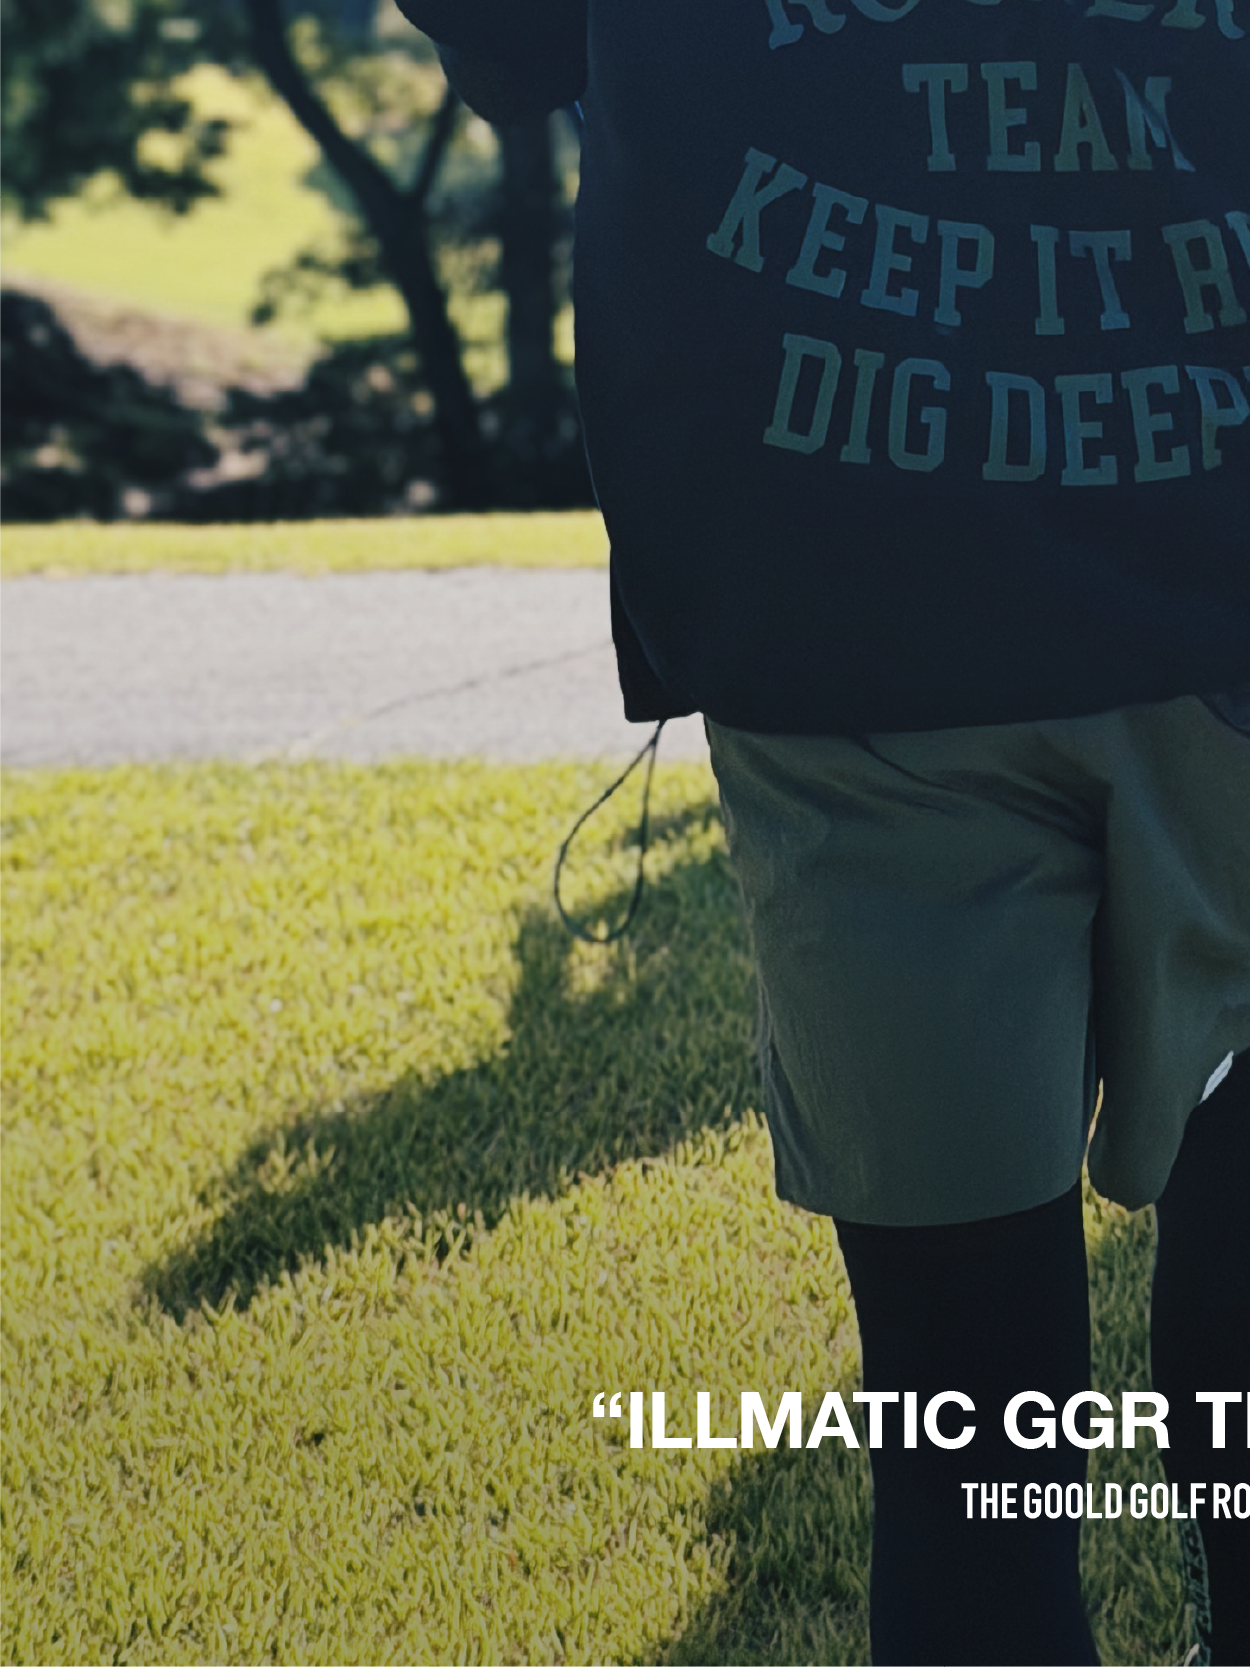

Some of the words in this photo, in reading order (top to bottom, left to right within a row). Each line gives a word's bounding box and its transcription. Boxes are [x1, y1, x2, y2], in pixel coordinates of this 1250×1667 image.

[705, 146, 996, 327] KEEP
[1030, 224, 1132, 335] IT
[762, 332, 952, 473] DIG
